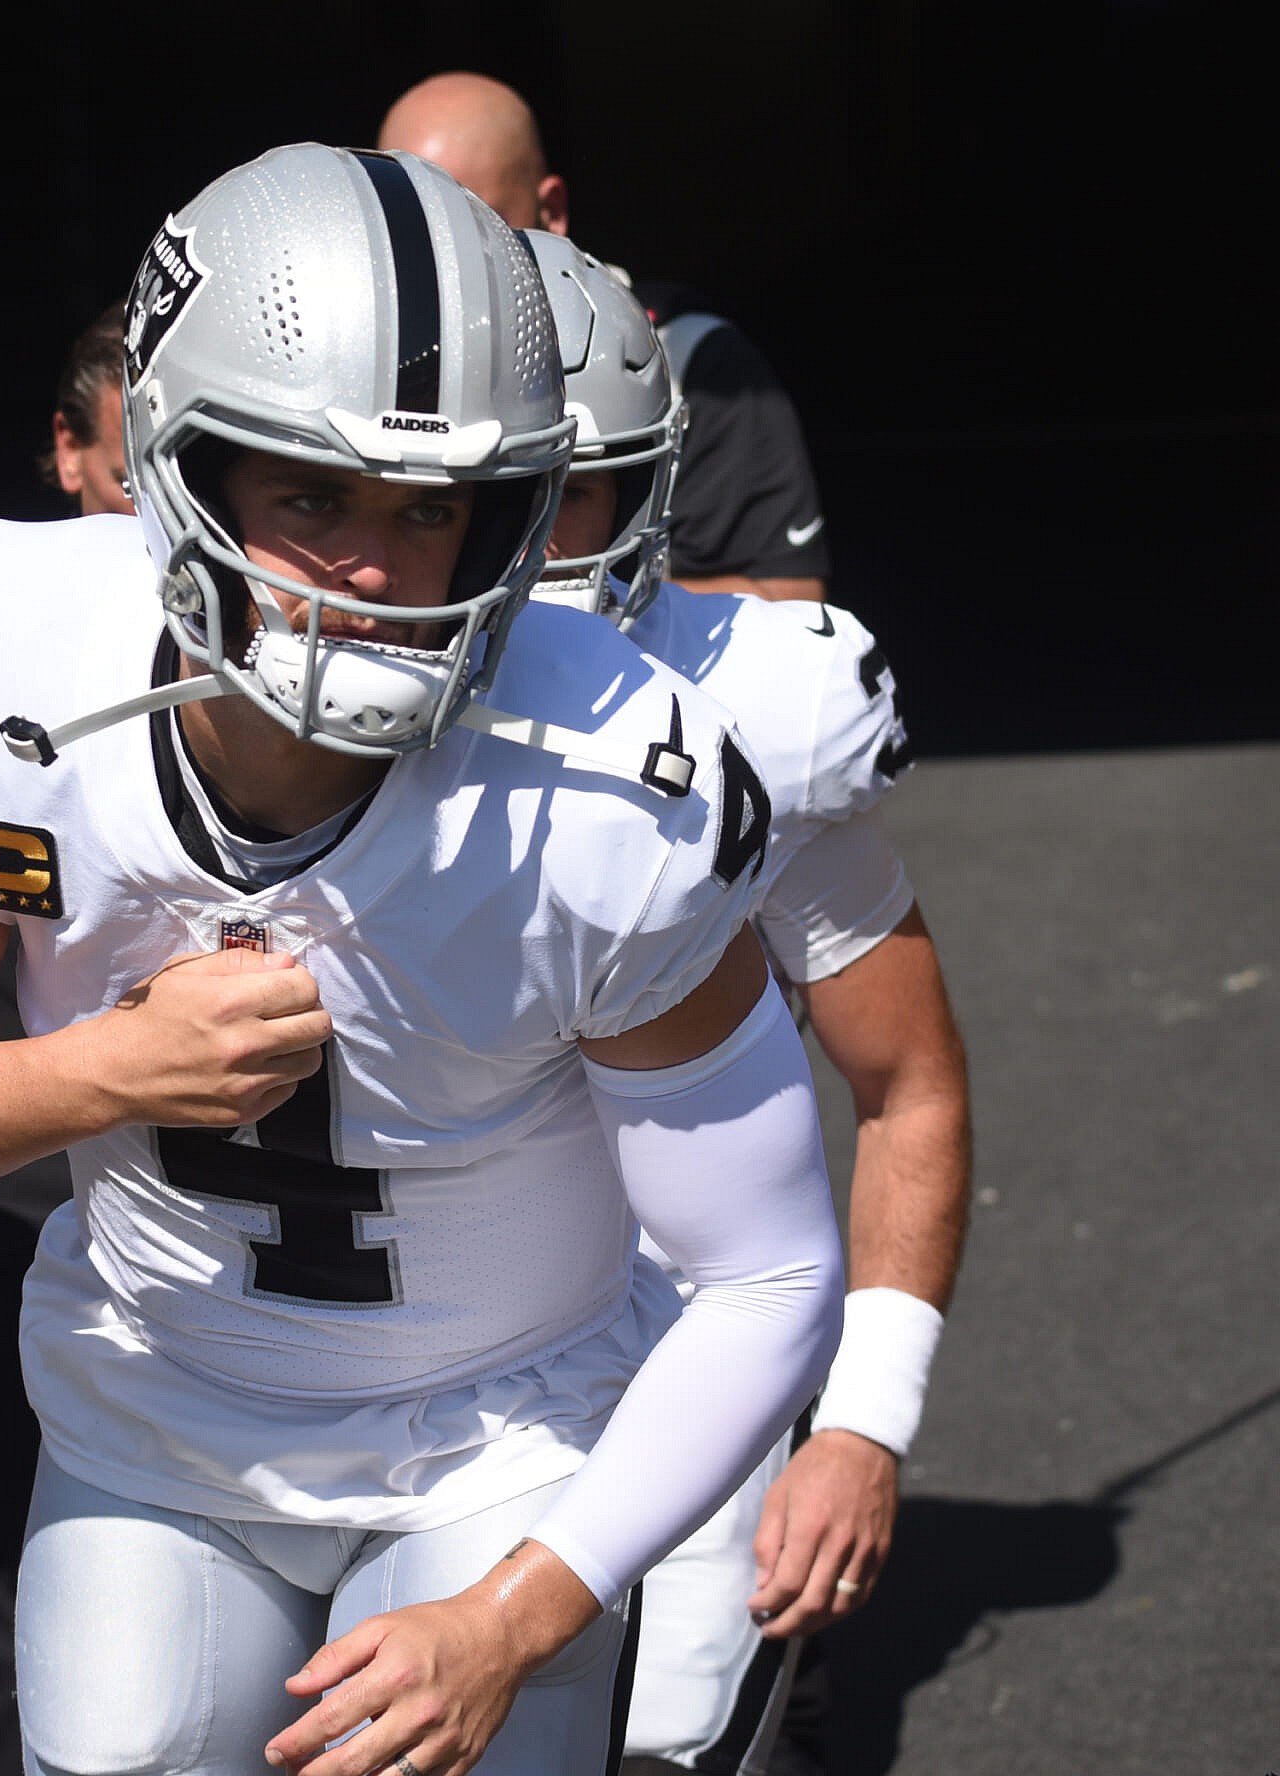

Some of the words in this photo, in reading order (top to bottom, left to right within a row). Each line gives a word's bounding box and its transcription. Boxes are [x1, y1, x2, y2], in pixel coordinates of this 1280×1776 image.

[381, 416, 450, 434] RAIDERS
[713, 728, 772, 888] 4
[154, 1036, 402, 1308] 4
